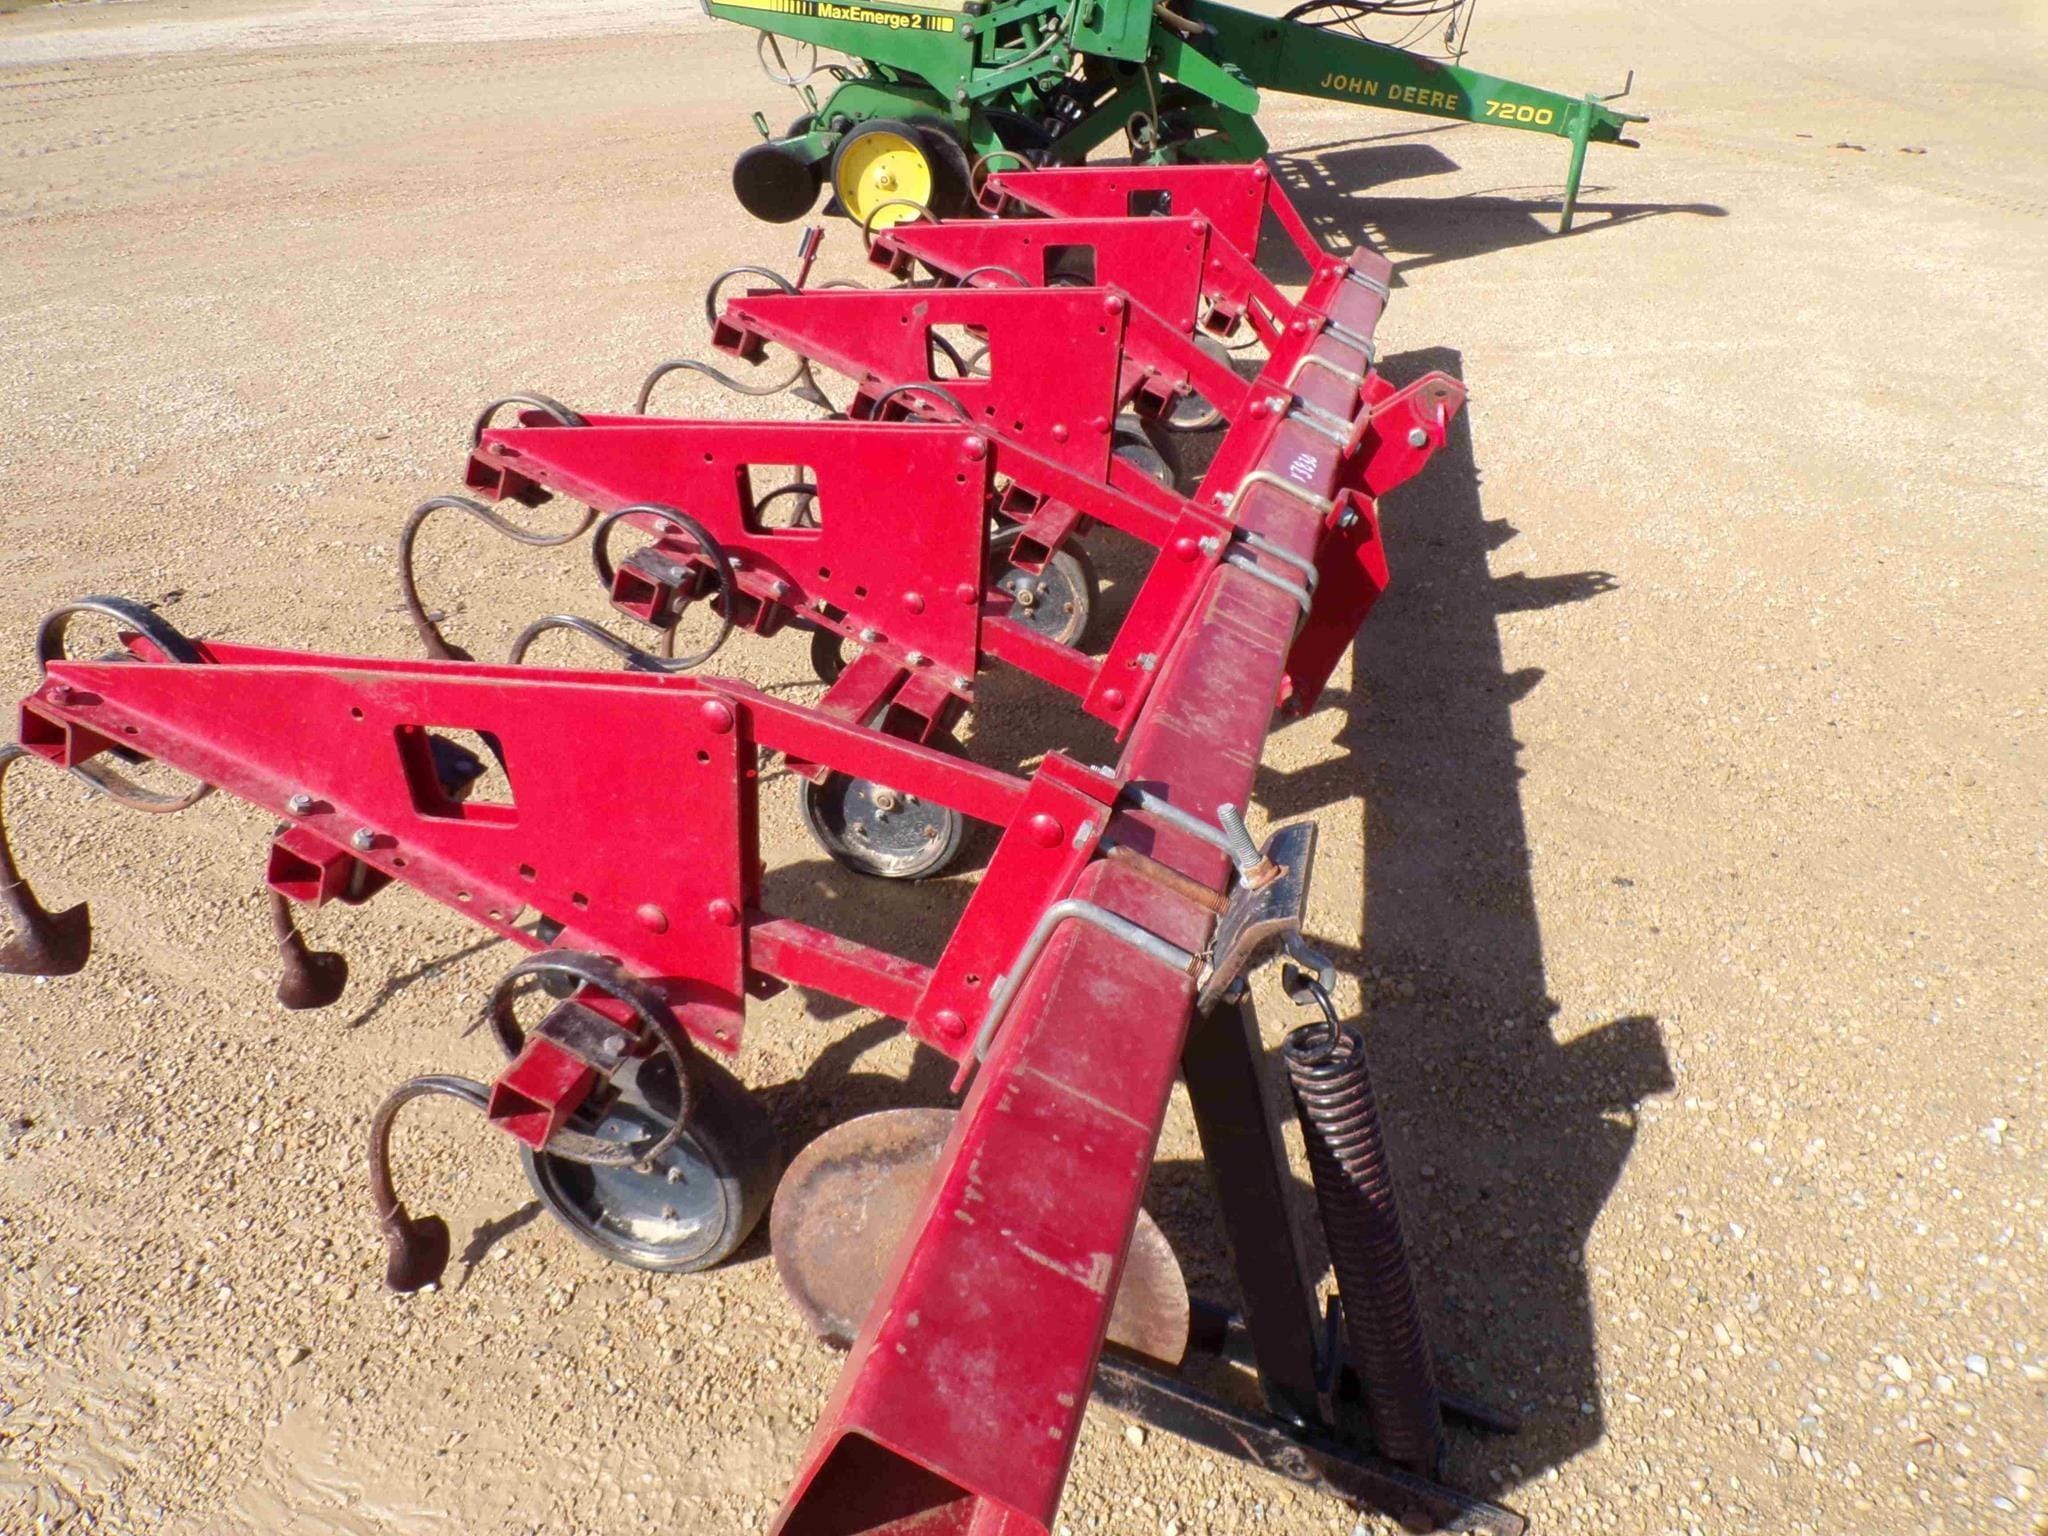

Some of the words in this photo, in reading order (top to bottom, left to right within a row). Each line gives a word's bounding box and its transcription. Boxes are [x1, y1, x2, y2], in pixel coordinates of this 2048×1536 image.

[817, 2, 910, 29] MaxEmerge
[911, 14, 922, 28] 2
[1320, 73, 1378, 97] JOHN
[1388, 84, 1458, 111] DEERE
[1485, 100, 1553, 125] 7200
